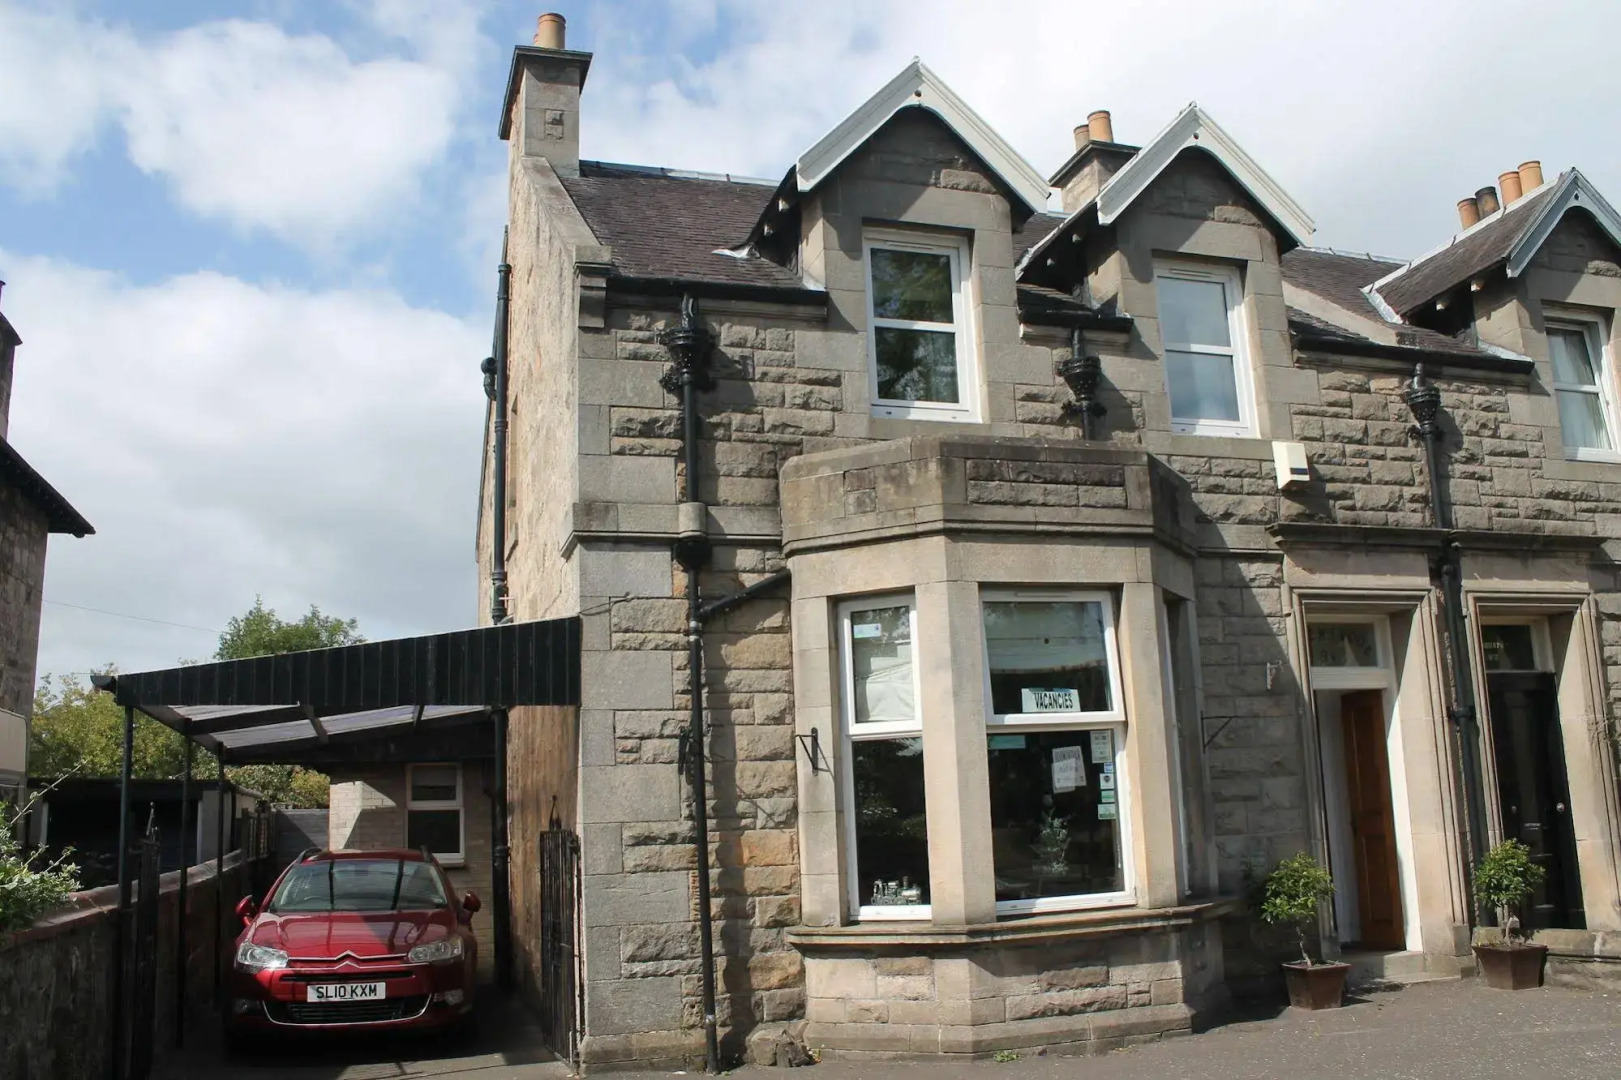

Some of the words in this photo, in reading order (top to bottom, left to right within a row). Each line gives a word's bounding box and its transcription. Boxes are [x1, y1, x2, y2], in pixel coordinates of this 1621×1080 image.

[1034, 692, 1073, 709] VACANCIES
[316, 985, 346, 999] SL10
[350, 984, 377, 997] KXM
